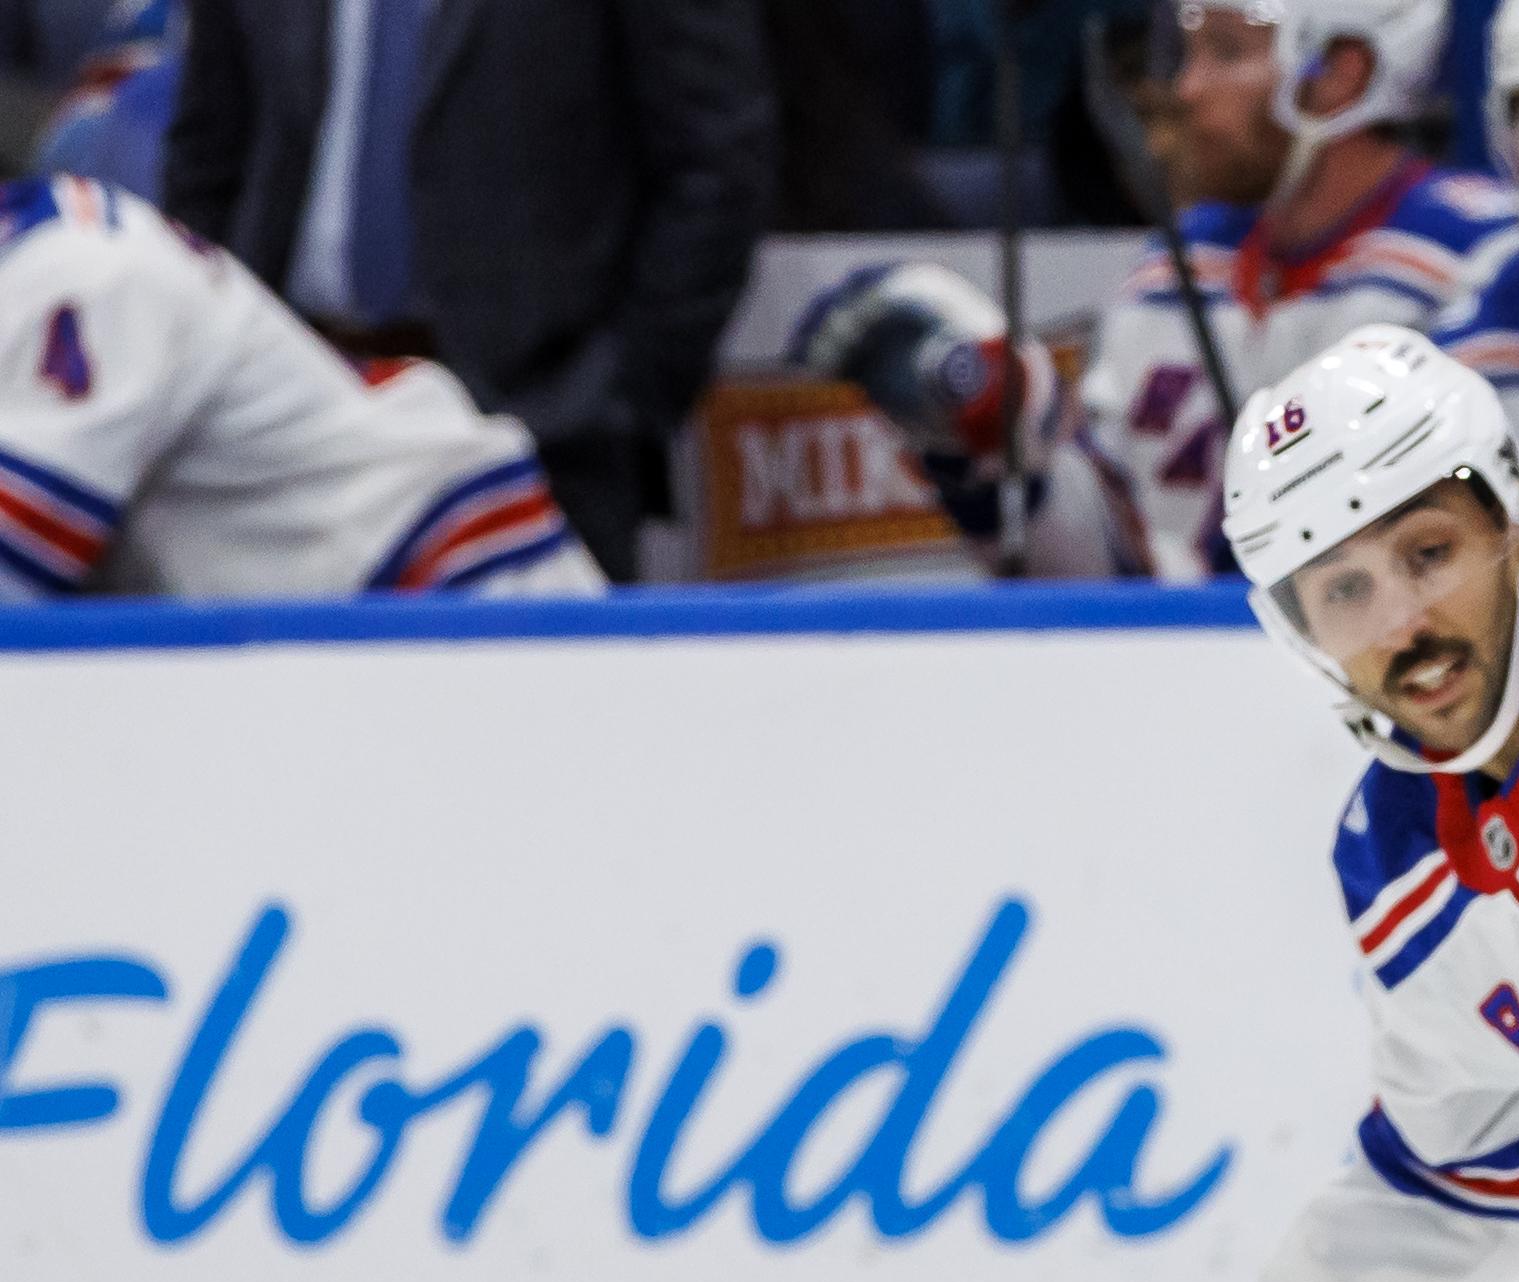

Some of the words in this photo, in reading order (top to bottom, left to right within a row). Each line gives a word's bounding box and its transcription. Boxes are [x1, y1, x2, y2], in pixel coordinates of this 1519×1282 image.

[38, 303, 93, 401] 4
[1264, 398, 1306, 449] 16
[0, 896, 1239, 1250] Florida
